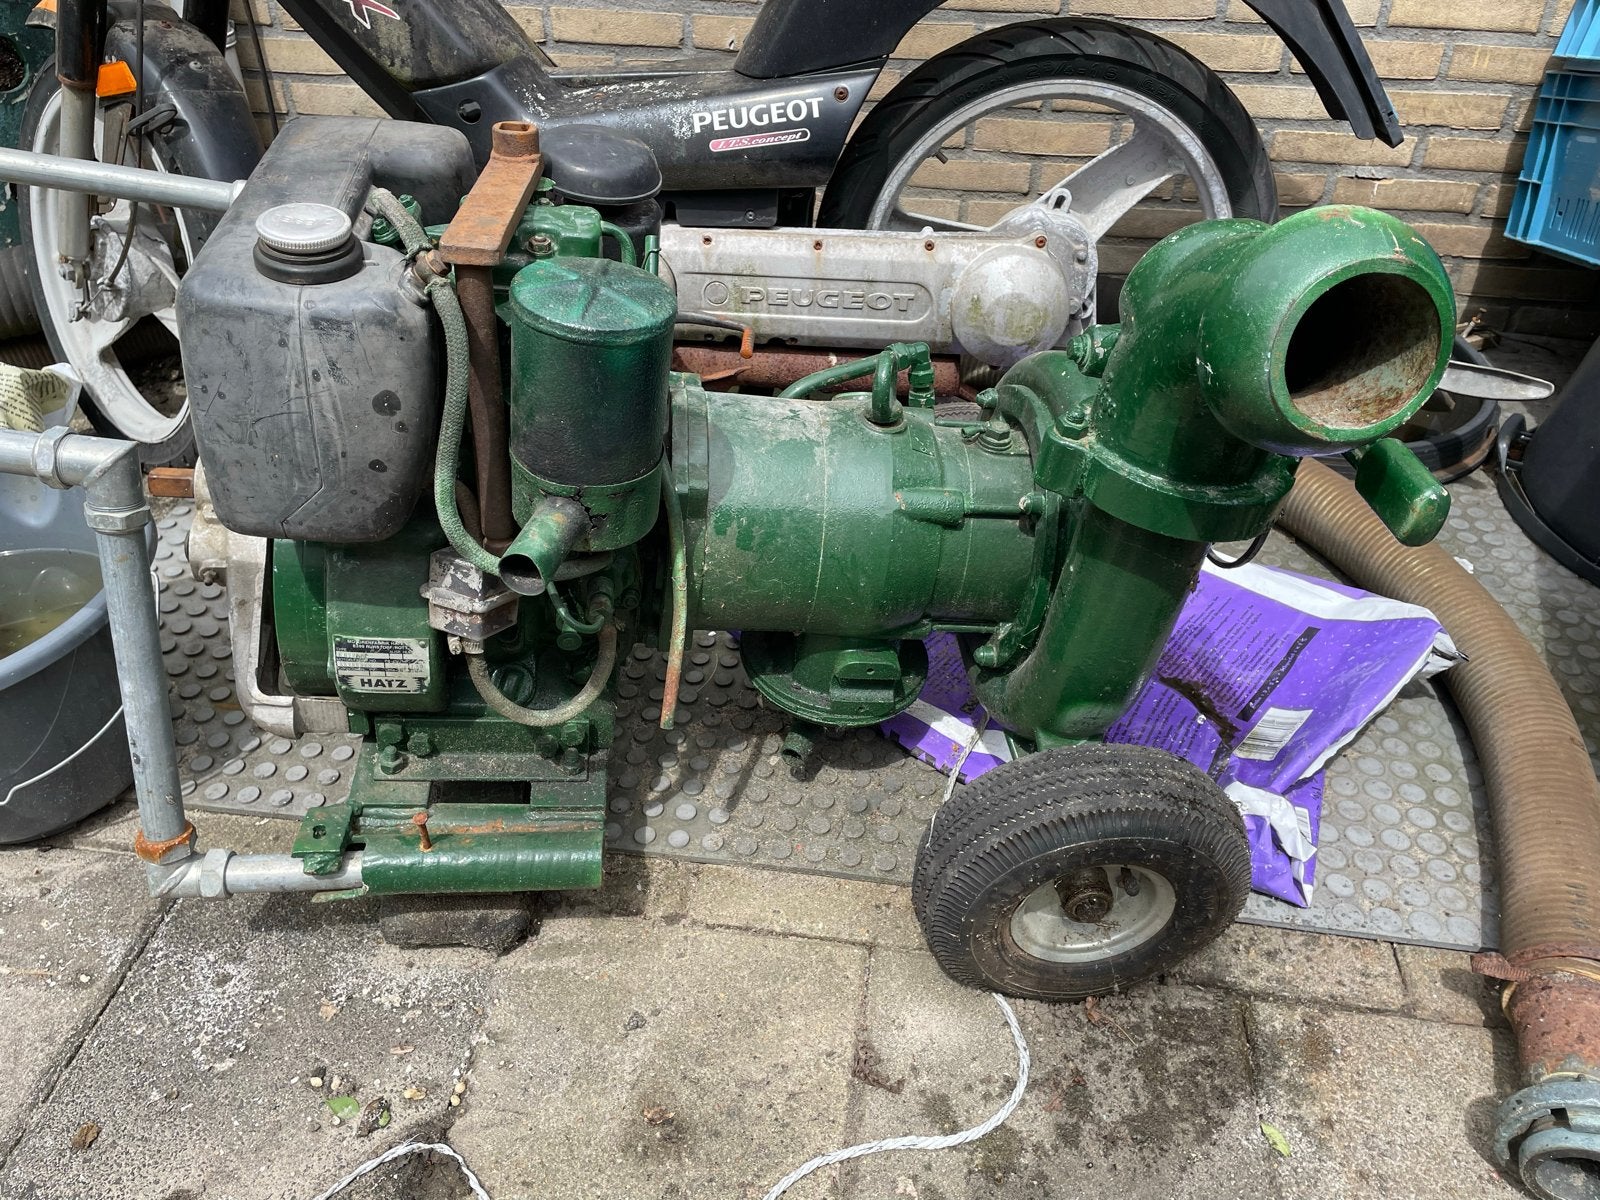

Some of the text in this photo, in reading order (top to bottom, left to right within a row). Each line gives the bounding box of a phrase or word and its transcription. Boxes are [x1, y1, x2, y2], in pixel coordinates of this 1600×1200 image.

[692, 97, 823, 133] PEUGEOT
[740, 286, 915, 312] PEUGEOT
[360, 678, 408, 688] HATZ
